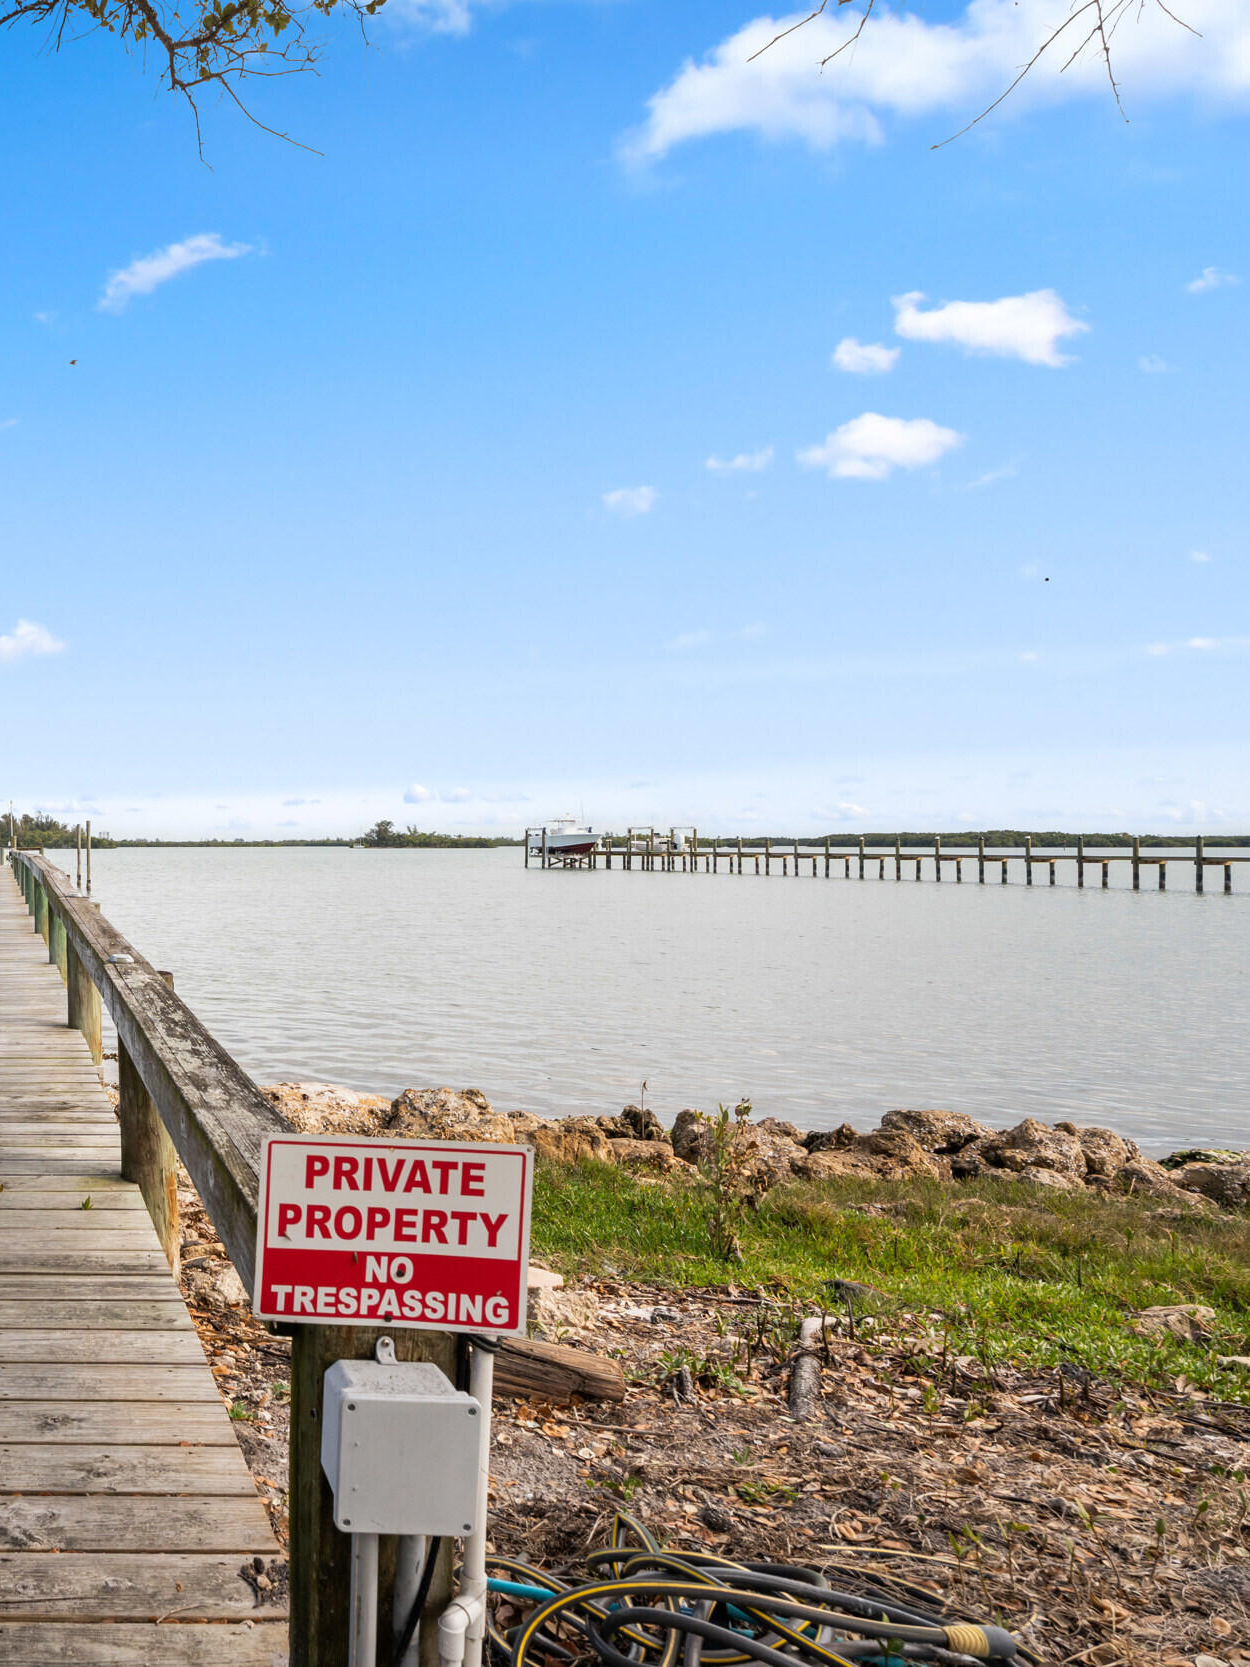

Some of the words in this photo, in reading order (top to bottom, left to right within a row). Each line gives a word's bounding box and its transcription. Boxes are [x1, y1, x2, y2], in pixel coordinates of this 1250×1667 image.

[305, 1154, 487, 1197] PRIVATE
[277, 1202, 509, 1248] PROPERTY
[365, 1255, 414, 1284] NO
[270, 1284, 510, 1325] TRESPASSING
